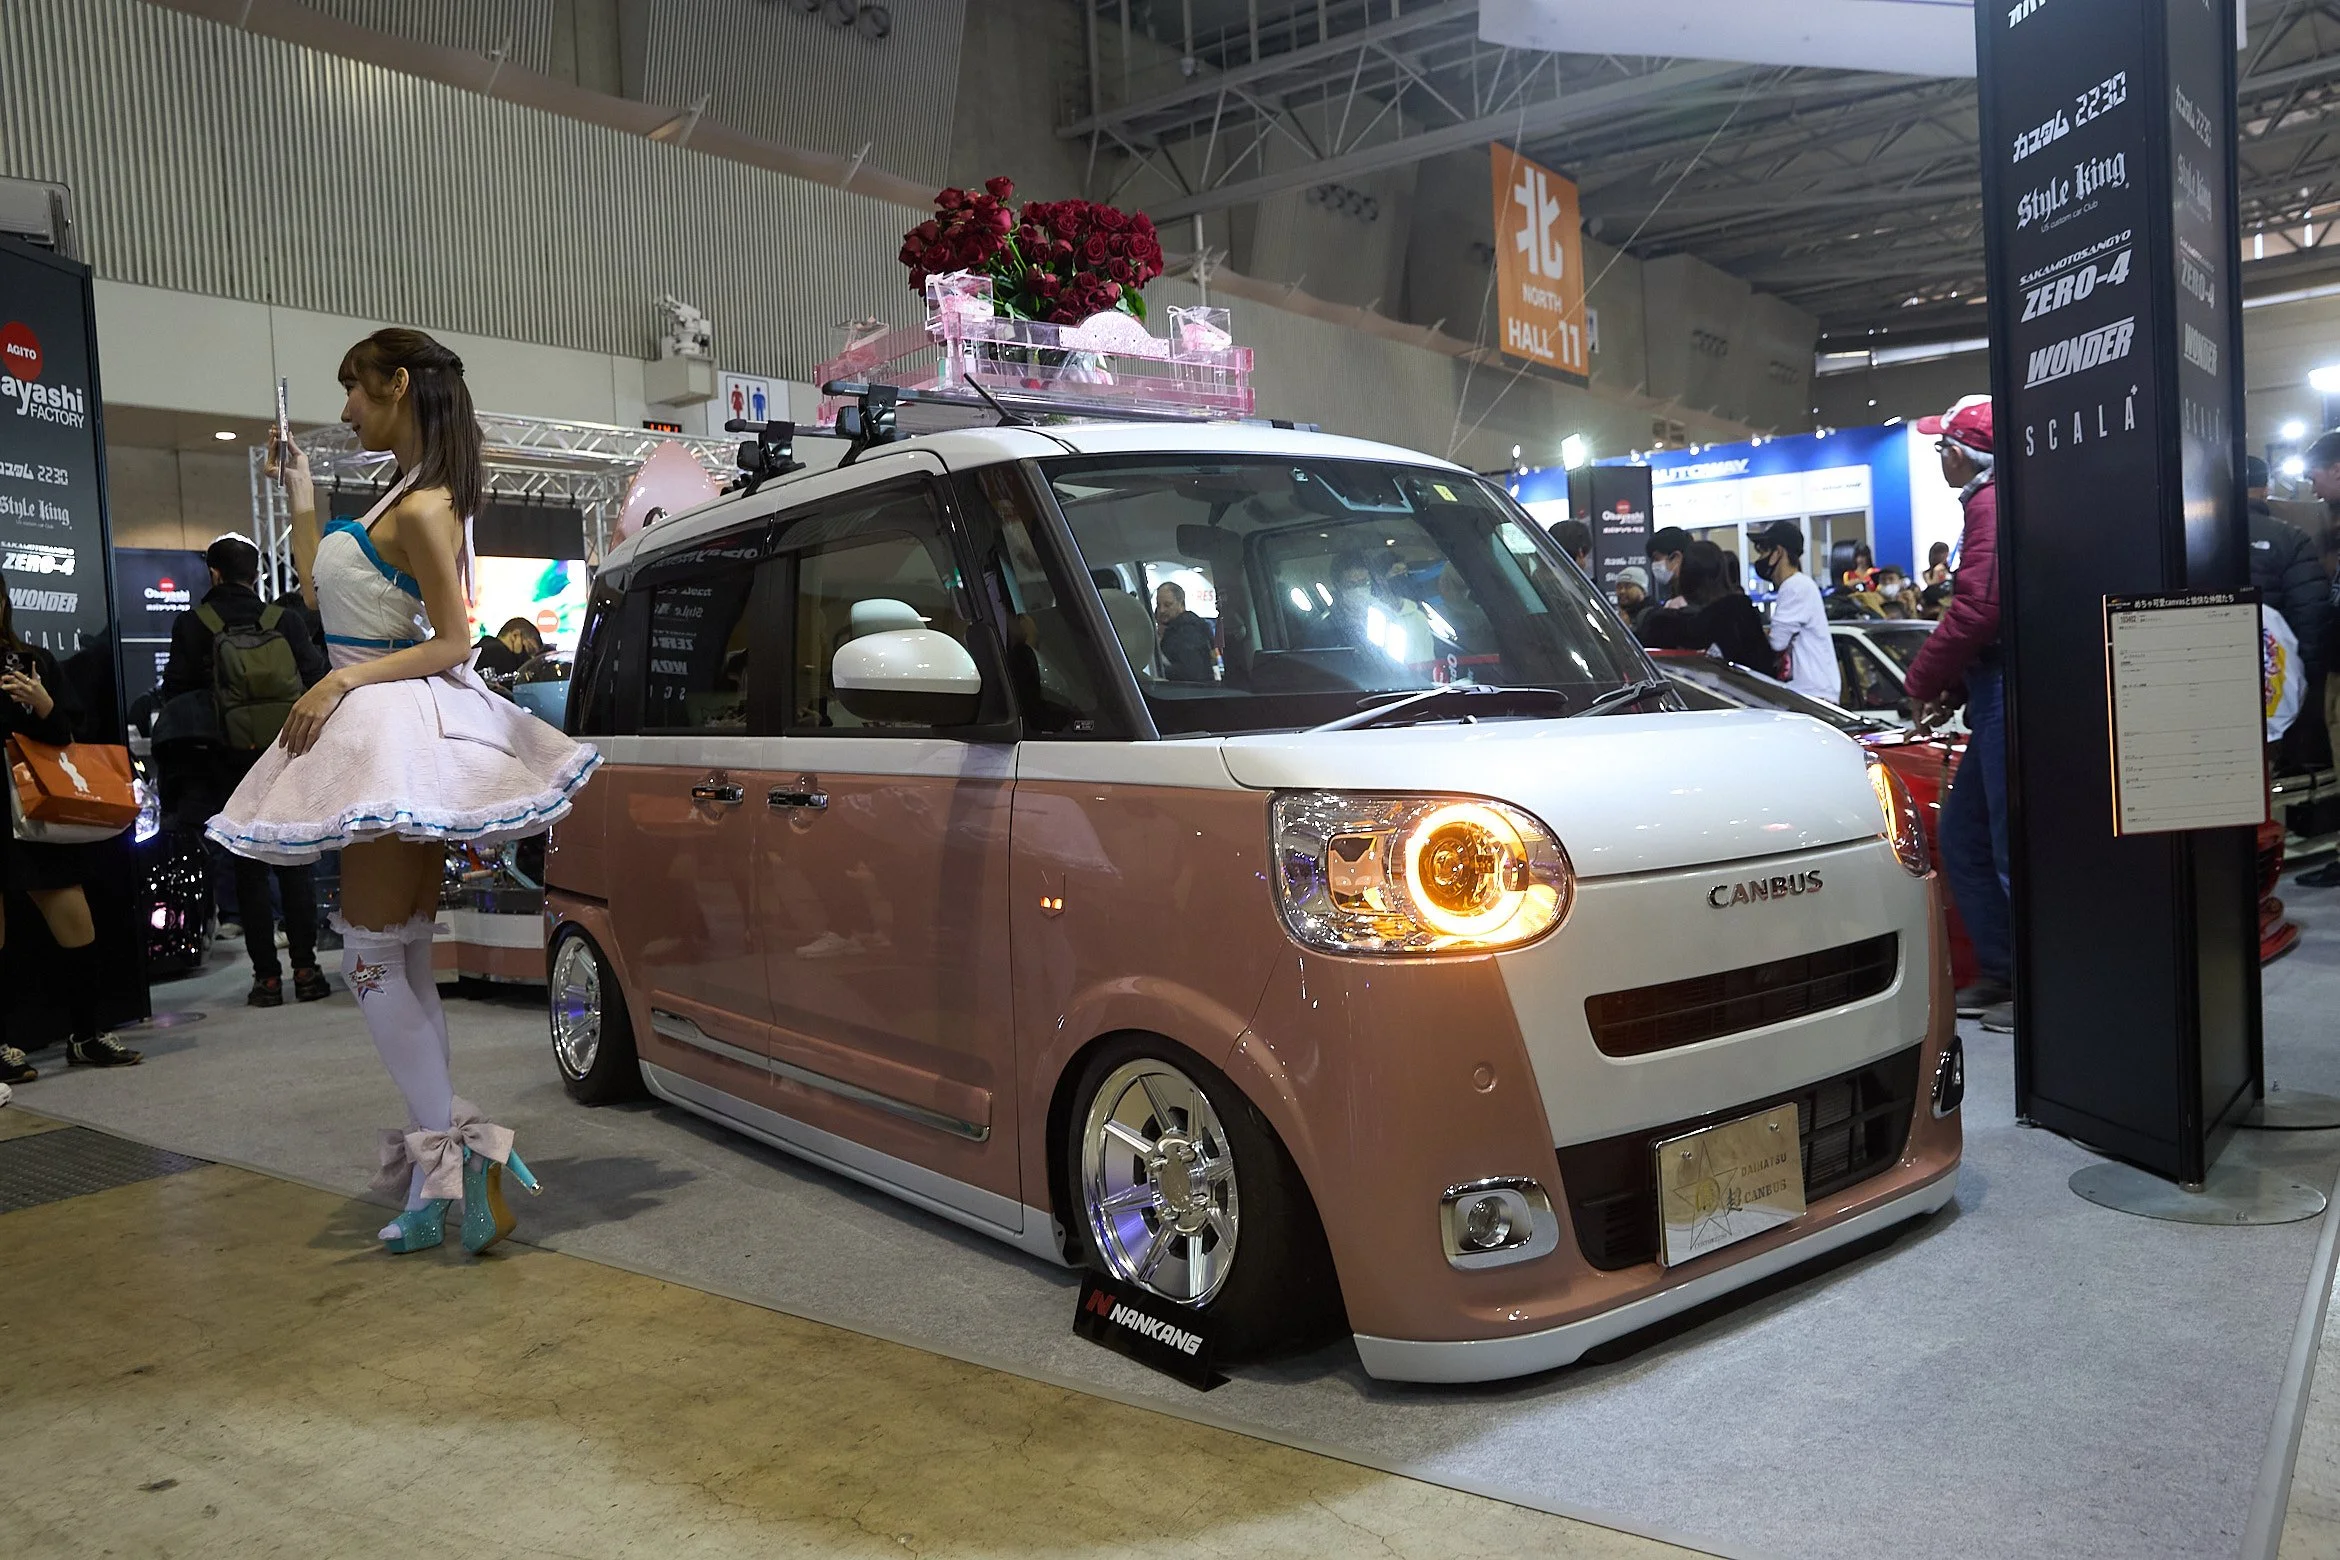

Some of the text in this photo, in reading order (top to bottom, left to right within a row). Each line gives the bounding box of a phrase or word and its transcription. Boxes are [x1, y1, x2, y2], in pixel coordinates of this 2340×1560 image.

[2075, 70, 2127, 128] 2230
[1514, 165, 1564, 280] 北
[2016, 176, 2069, 230] Style
[2019, 229, 2132, 286] SAKAMOTOSANGYO
[1523, 282, 1563, 313] NORTH
[2021, 250, 2132, 323] ZERO-4
[2181, 258, 2216, 310] ZERO-4
[7, 343, 37, 360] AGITO
[1508, 317, 1581, 368] HALL 11
[2024, 316, 2135, 390] WONDER
[2184, 322, 2218, 377] WONDER
[30, 402, 84, 429] FACTORY
[37, 464, 69, 486] 2230
[0, 495, 35, 519] Style
[2, 552, 76, 576] ZERO-4
[9, 588, 79, 613] WONDER
[1707, 870, 1824, 909] CANBUS
[1741, 1152, 1787, 1178] DAIHATSU
[1744, 1179, 1787, 1204] CANBUS
[1109, 1303, 1203, 1356] NANKANG
